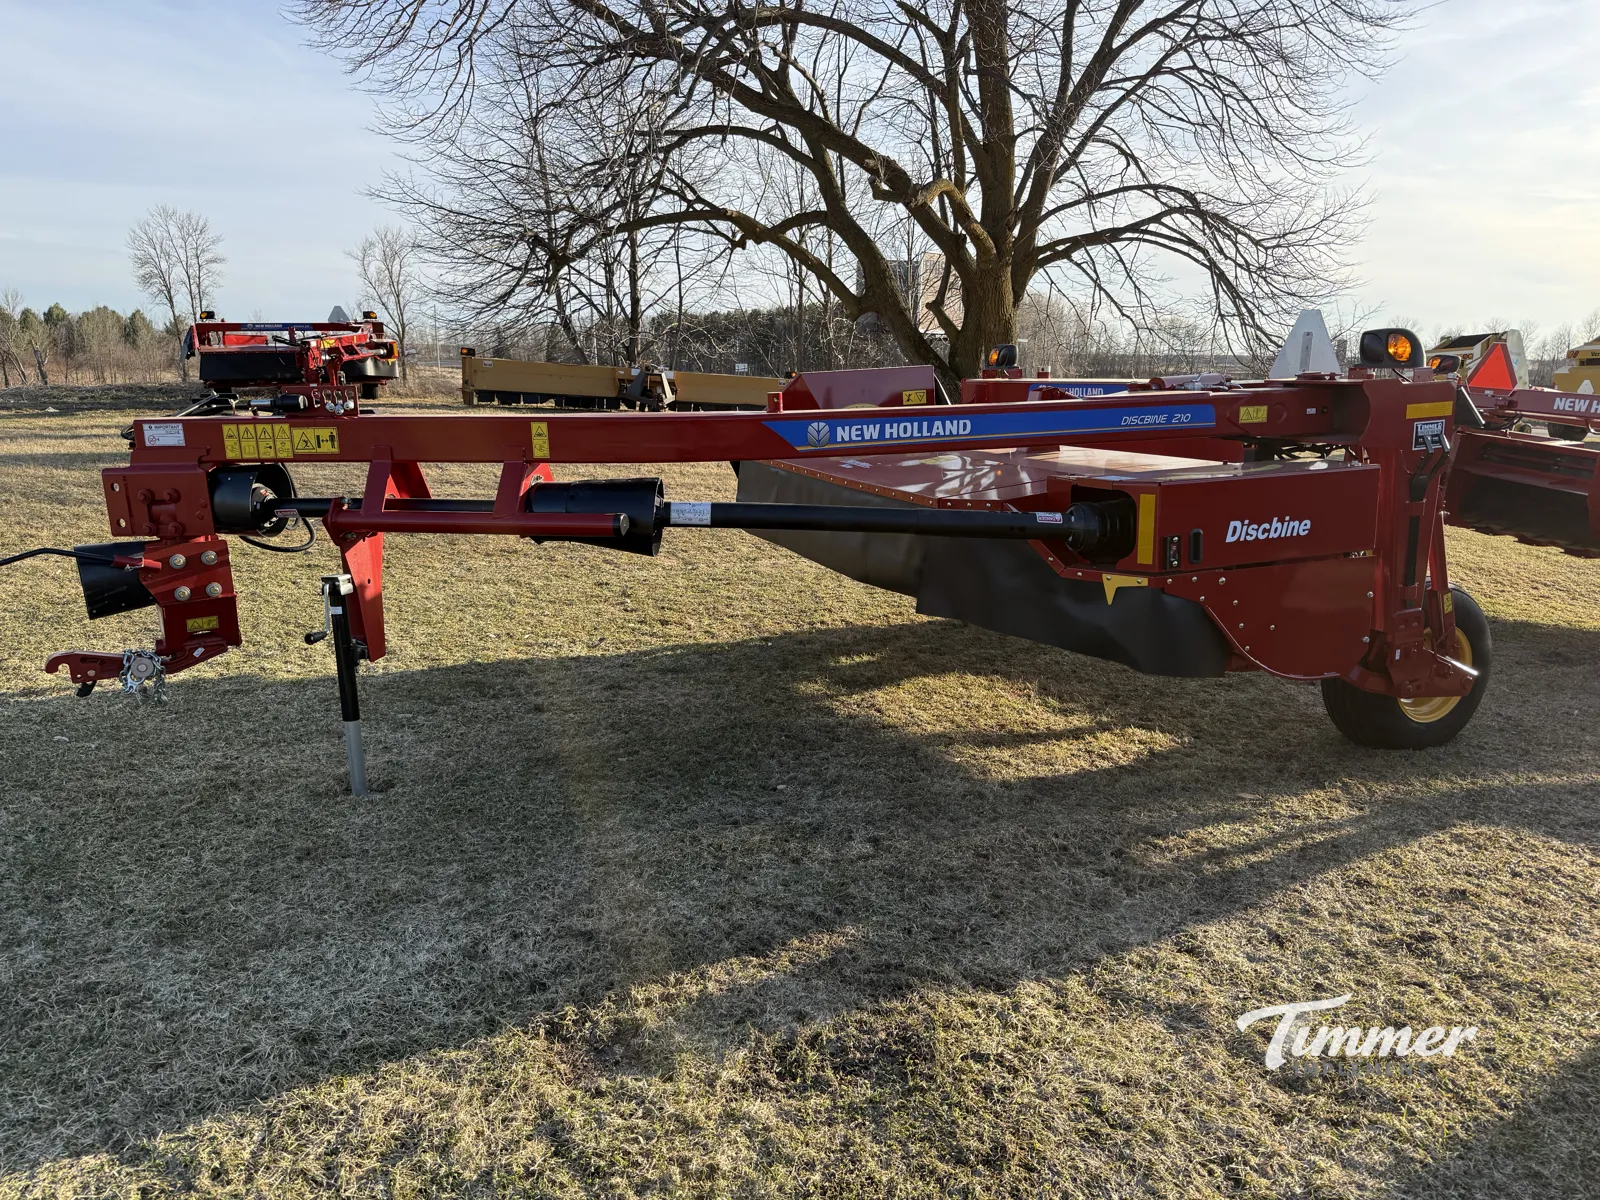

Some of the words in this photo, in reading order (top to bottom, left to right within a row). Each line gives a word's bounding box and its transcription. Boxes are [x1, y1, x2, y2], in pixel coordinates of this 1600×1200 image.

[1553, 397, 1590, 413] NEW
[1121, 414, 1168, 426] DISCBINE
[1172, 413, 1191, 423] 210
[836, 423, 881, 442] NEW
[885, 419, 972, 440] HOLLAND
[1225, 515, 1312, 543] Discbine
